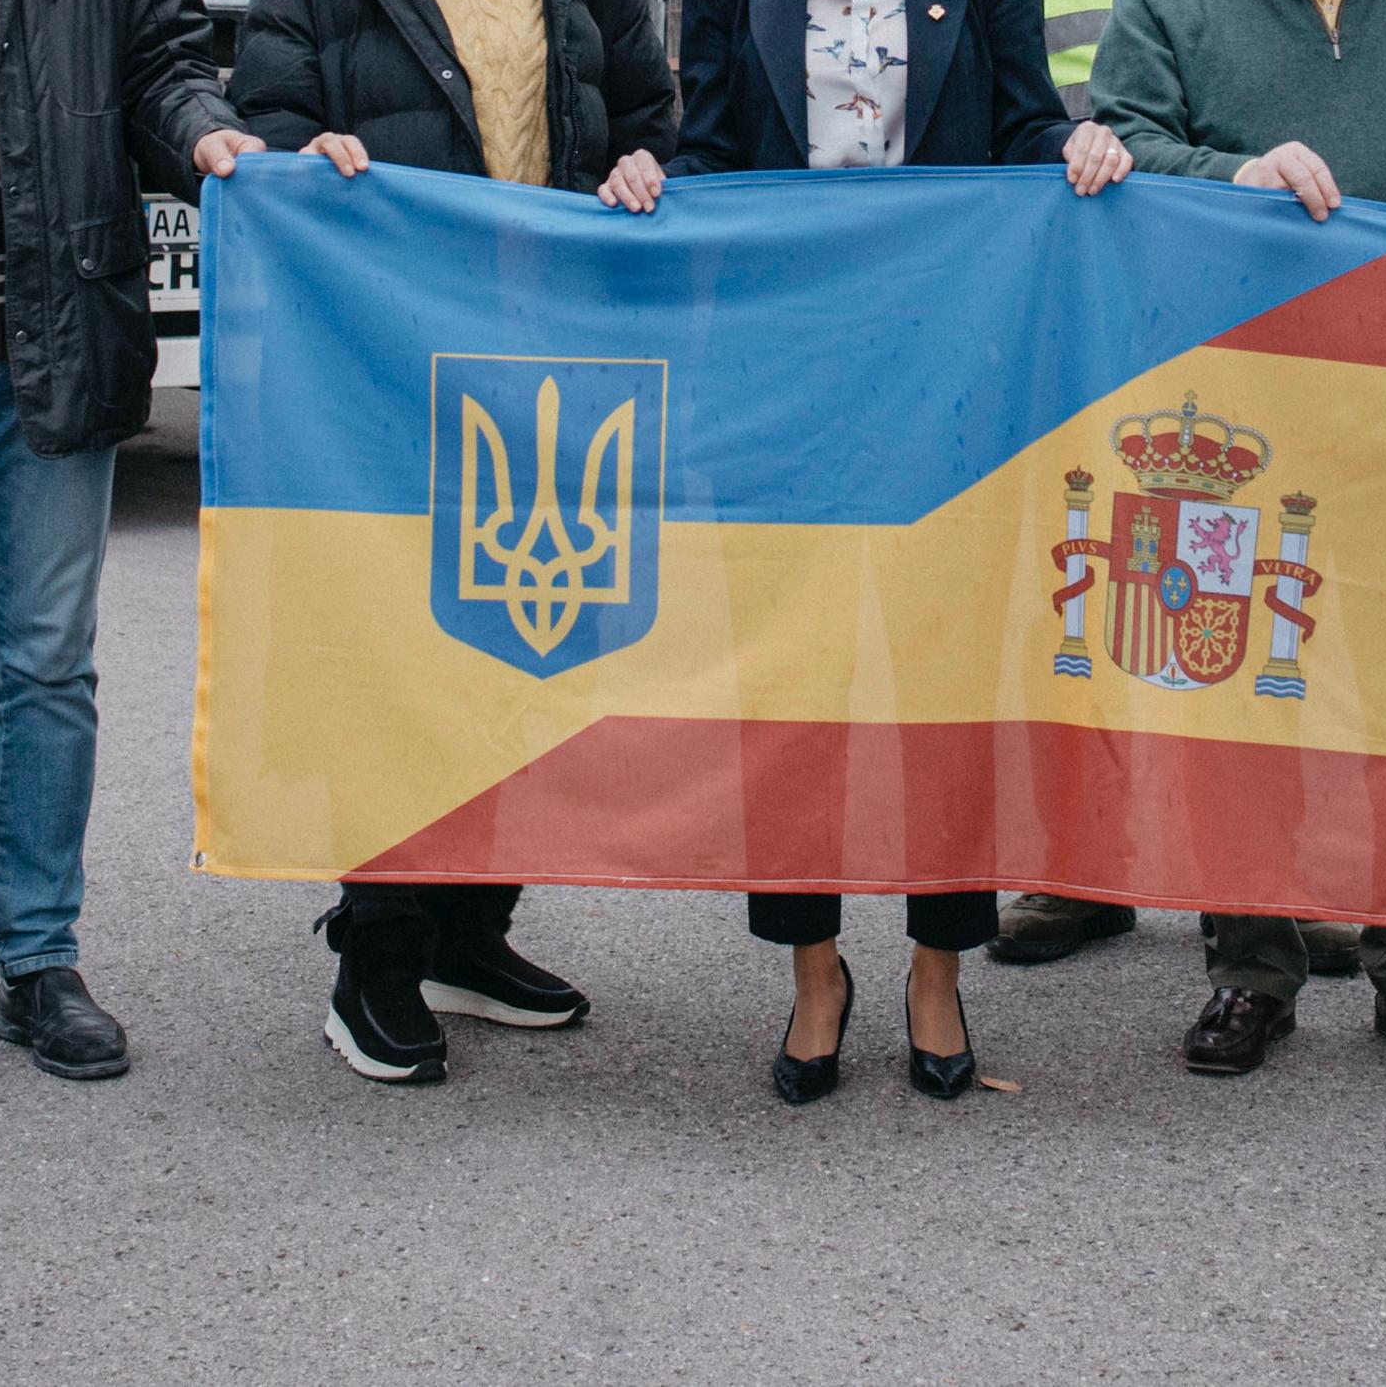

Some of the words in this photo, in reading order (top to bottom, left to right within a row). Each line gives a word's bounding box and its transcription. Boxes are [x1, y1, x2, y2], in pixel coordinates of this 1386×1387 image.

[152, 208, 191, 238] AA
[1061, 540, 1098, 556] PLVS
[1260, 561, 1316, 586] VLTRA
